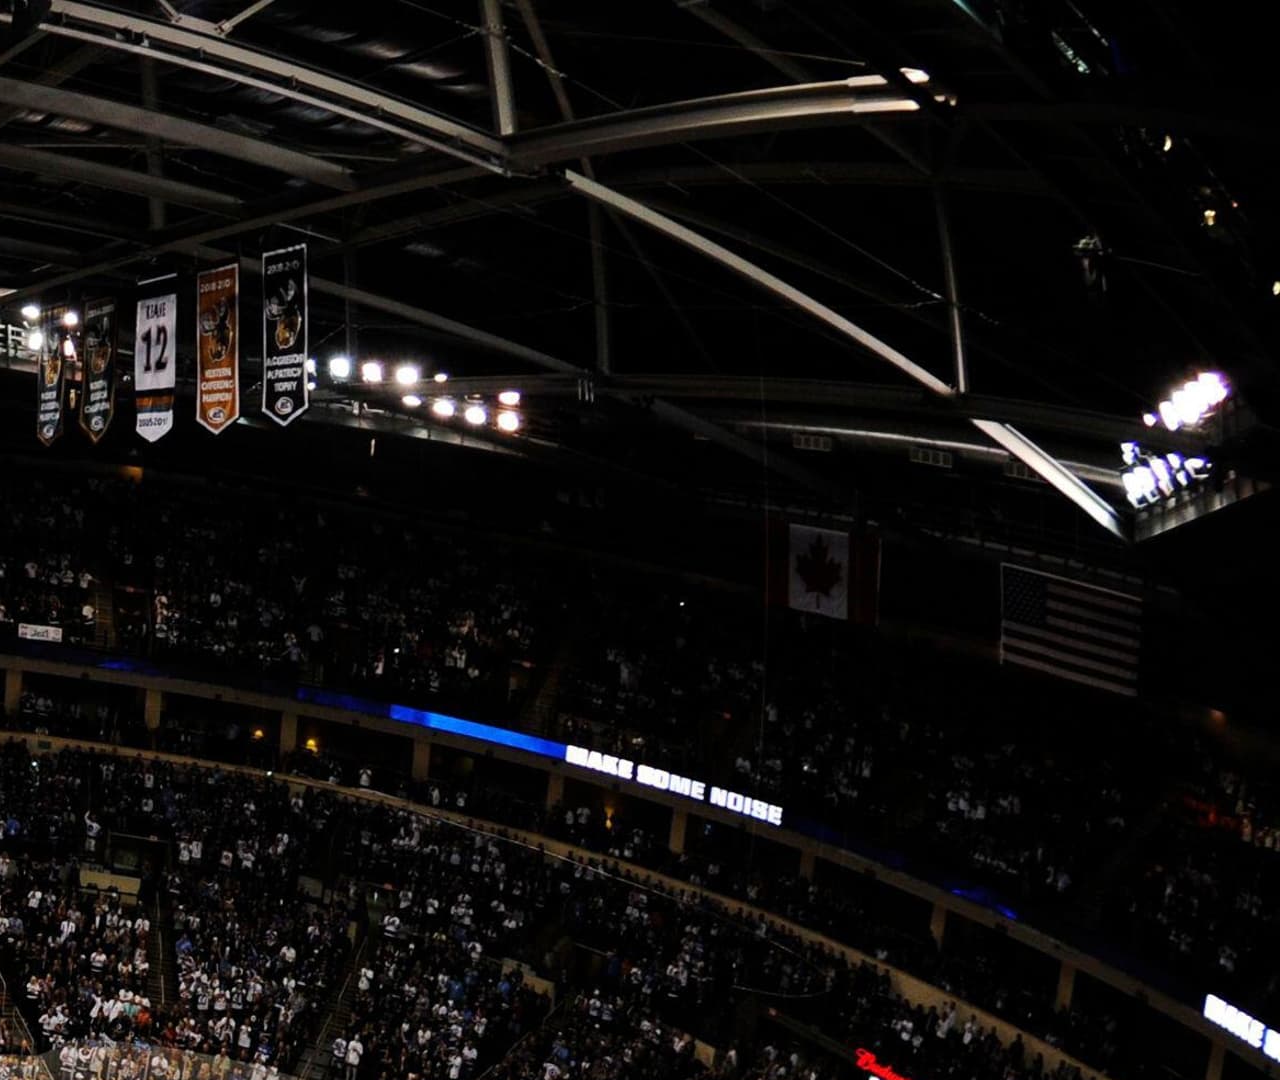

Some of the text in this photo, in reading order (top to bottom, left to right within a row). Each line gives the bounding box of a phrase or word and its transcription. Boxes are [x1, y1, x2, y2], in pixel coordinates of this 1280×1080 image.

[141, 325, 168, 373] 12
[565, 744, 783, 826] MAKE SOME NOISE
